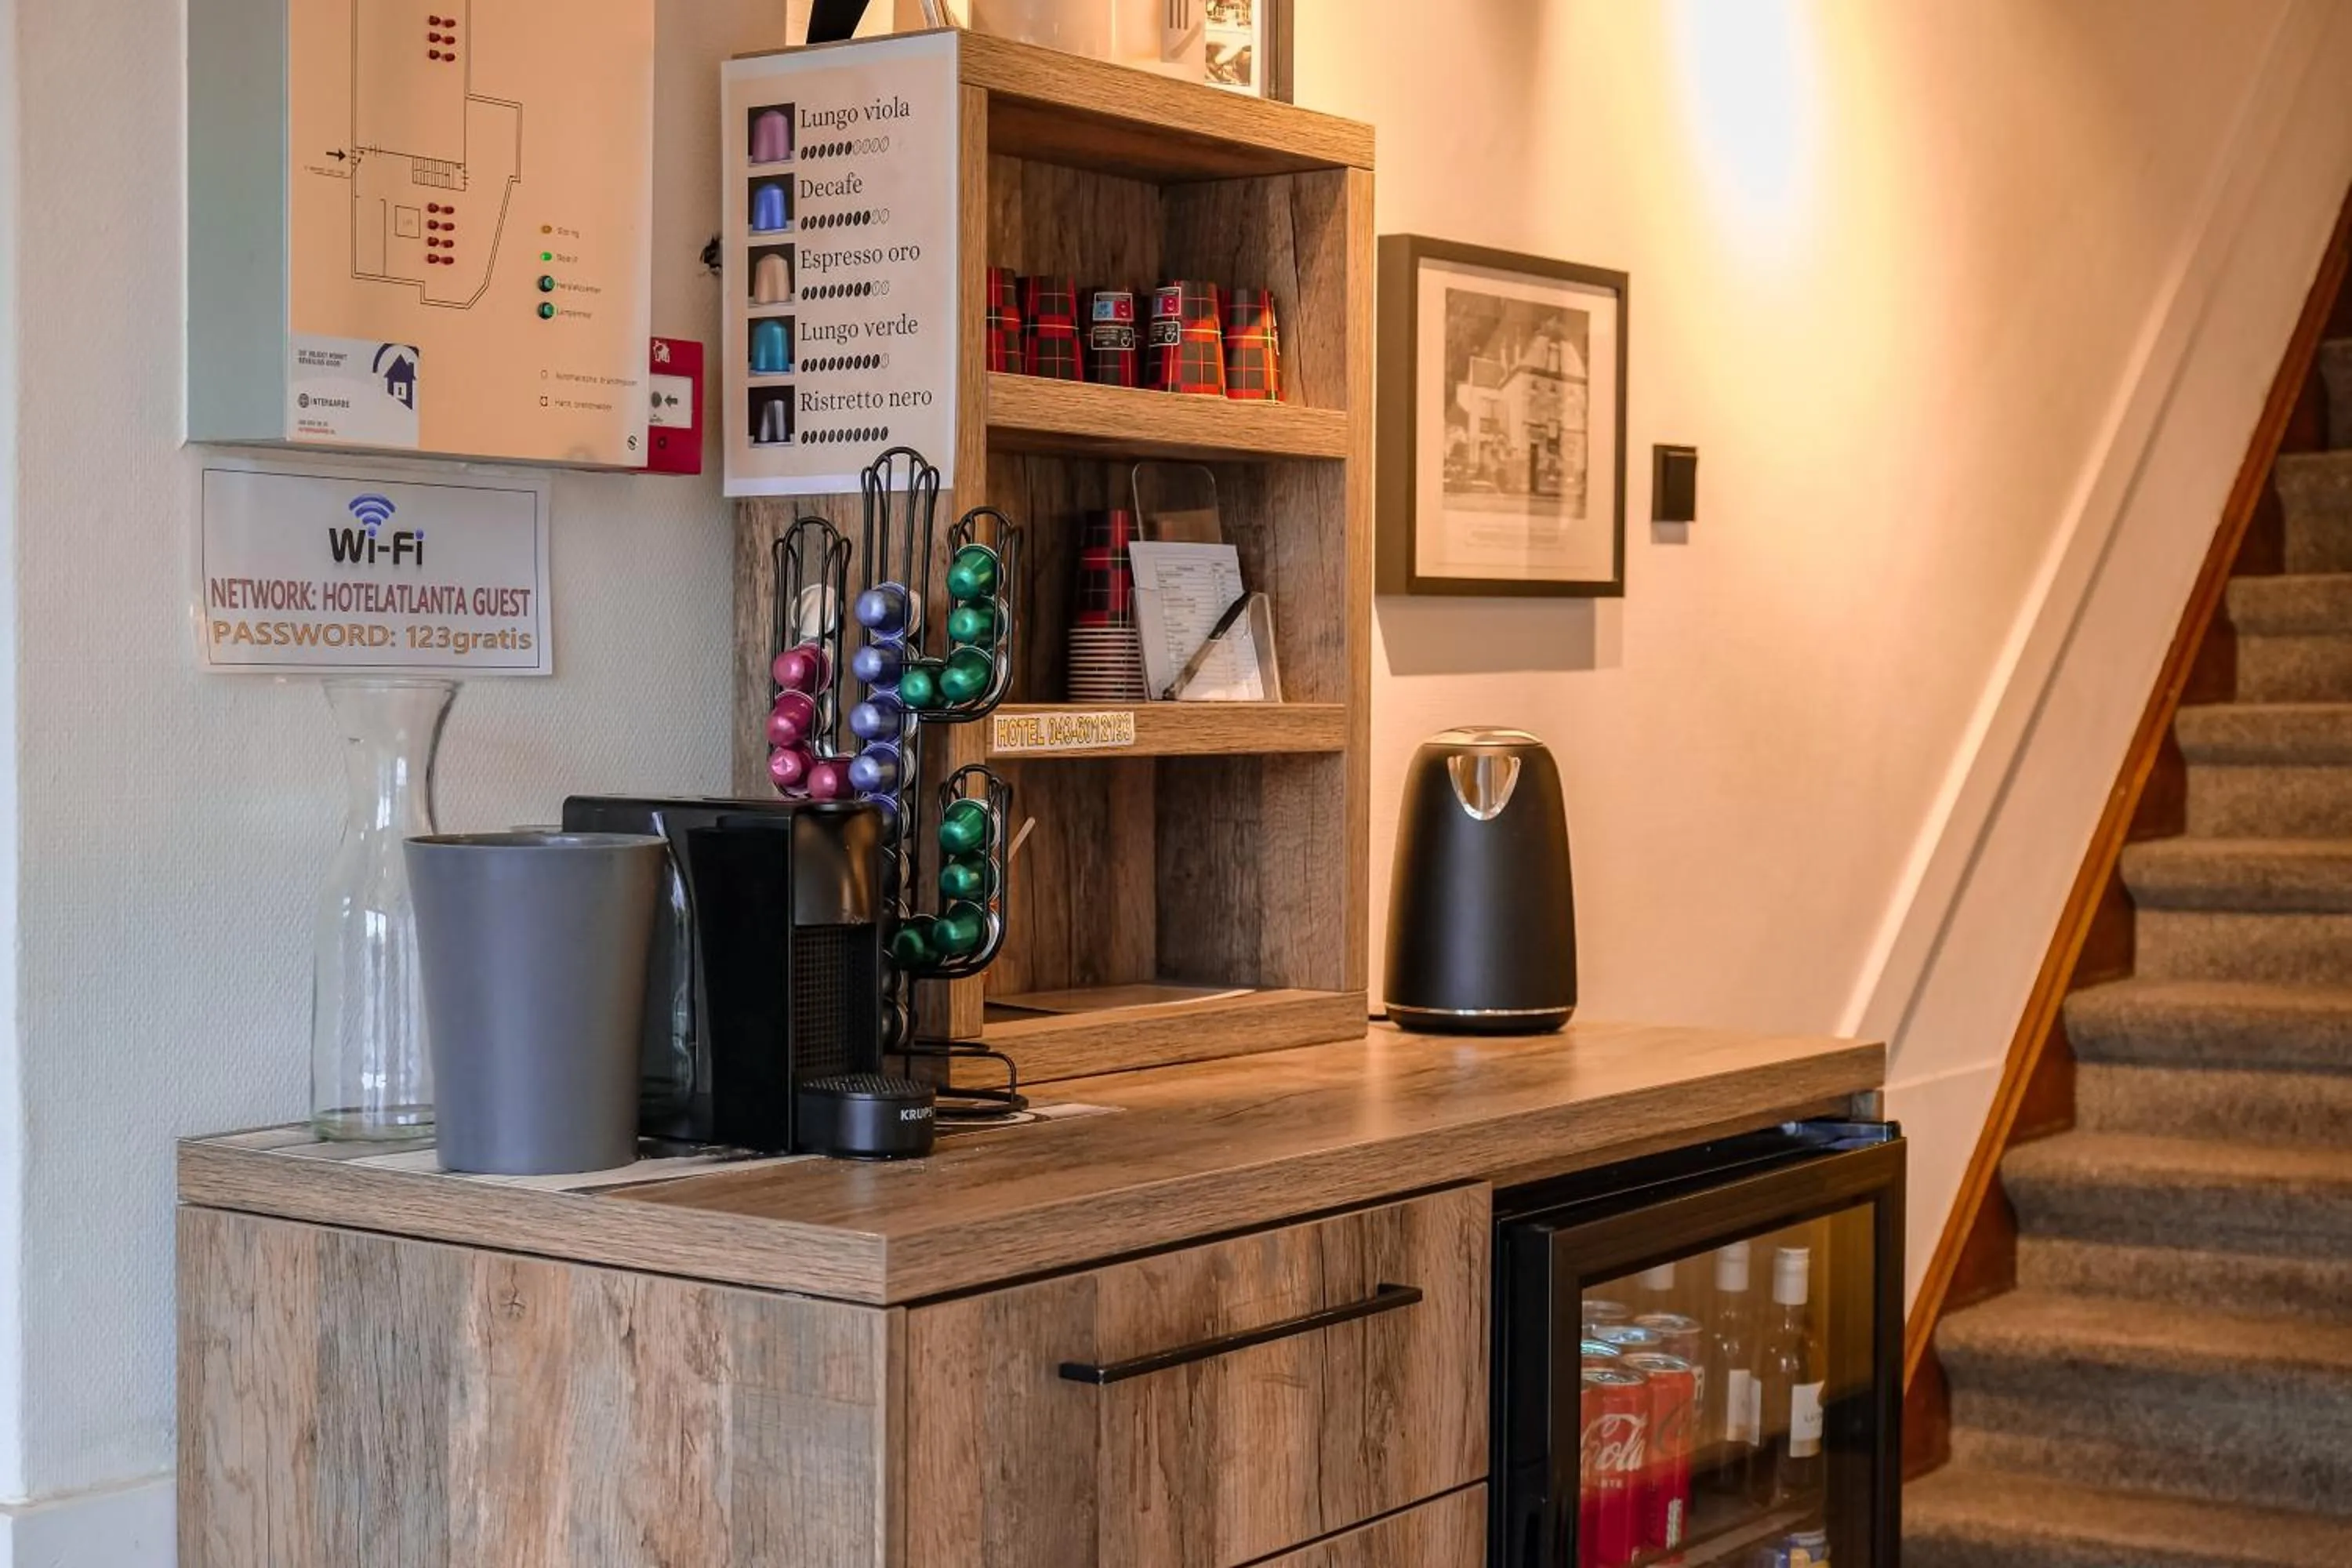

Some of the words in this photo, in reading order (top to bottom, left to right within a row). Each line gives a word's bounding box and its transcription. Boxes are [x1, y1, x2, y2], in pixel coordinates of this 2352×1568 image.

[800, 107, 858, 130] Lungo
[863, 96, 910, 120] viola
[800, 172, 862, 198] Decafe
[800, 248, 883, 273] Espresso
[888, 245, 920, 263] oro
[800, 322, 859, 345] Lungo
[864, 313, 918, 337] verde
[800, 390, 884, 412] Ristretto
[889, 390, 932, 407] nero
[329, 527, 424, 565] Wi-Fi
[211, 579, 317, 611] NETWORK:
[323, 583, 468, 616] HOTELATLANTA
[473, 588, 531, 617] GUEST
[212, 620, 397, 648] PASSWORD:
[406, 626, 533, 655] 123gratis
[996, 717, 1045, 748] HOTEL
[900, 1106, 932, 1120] KRUPS
